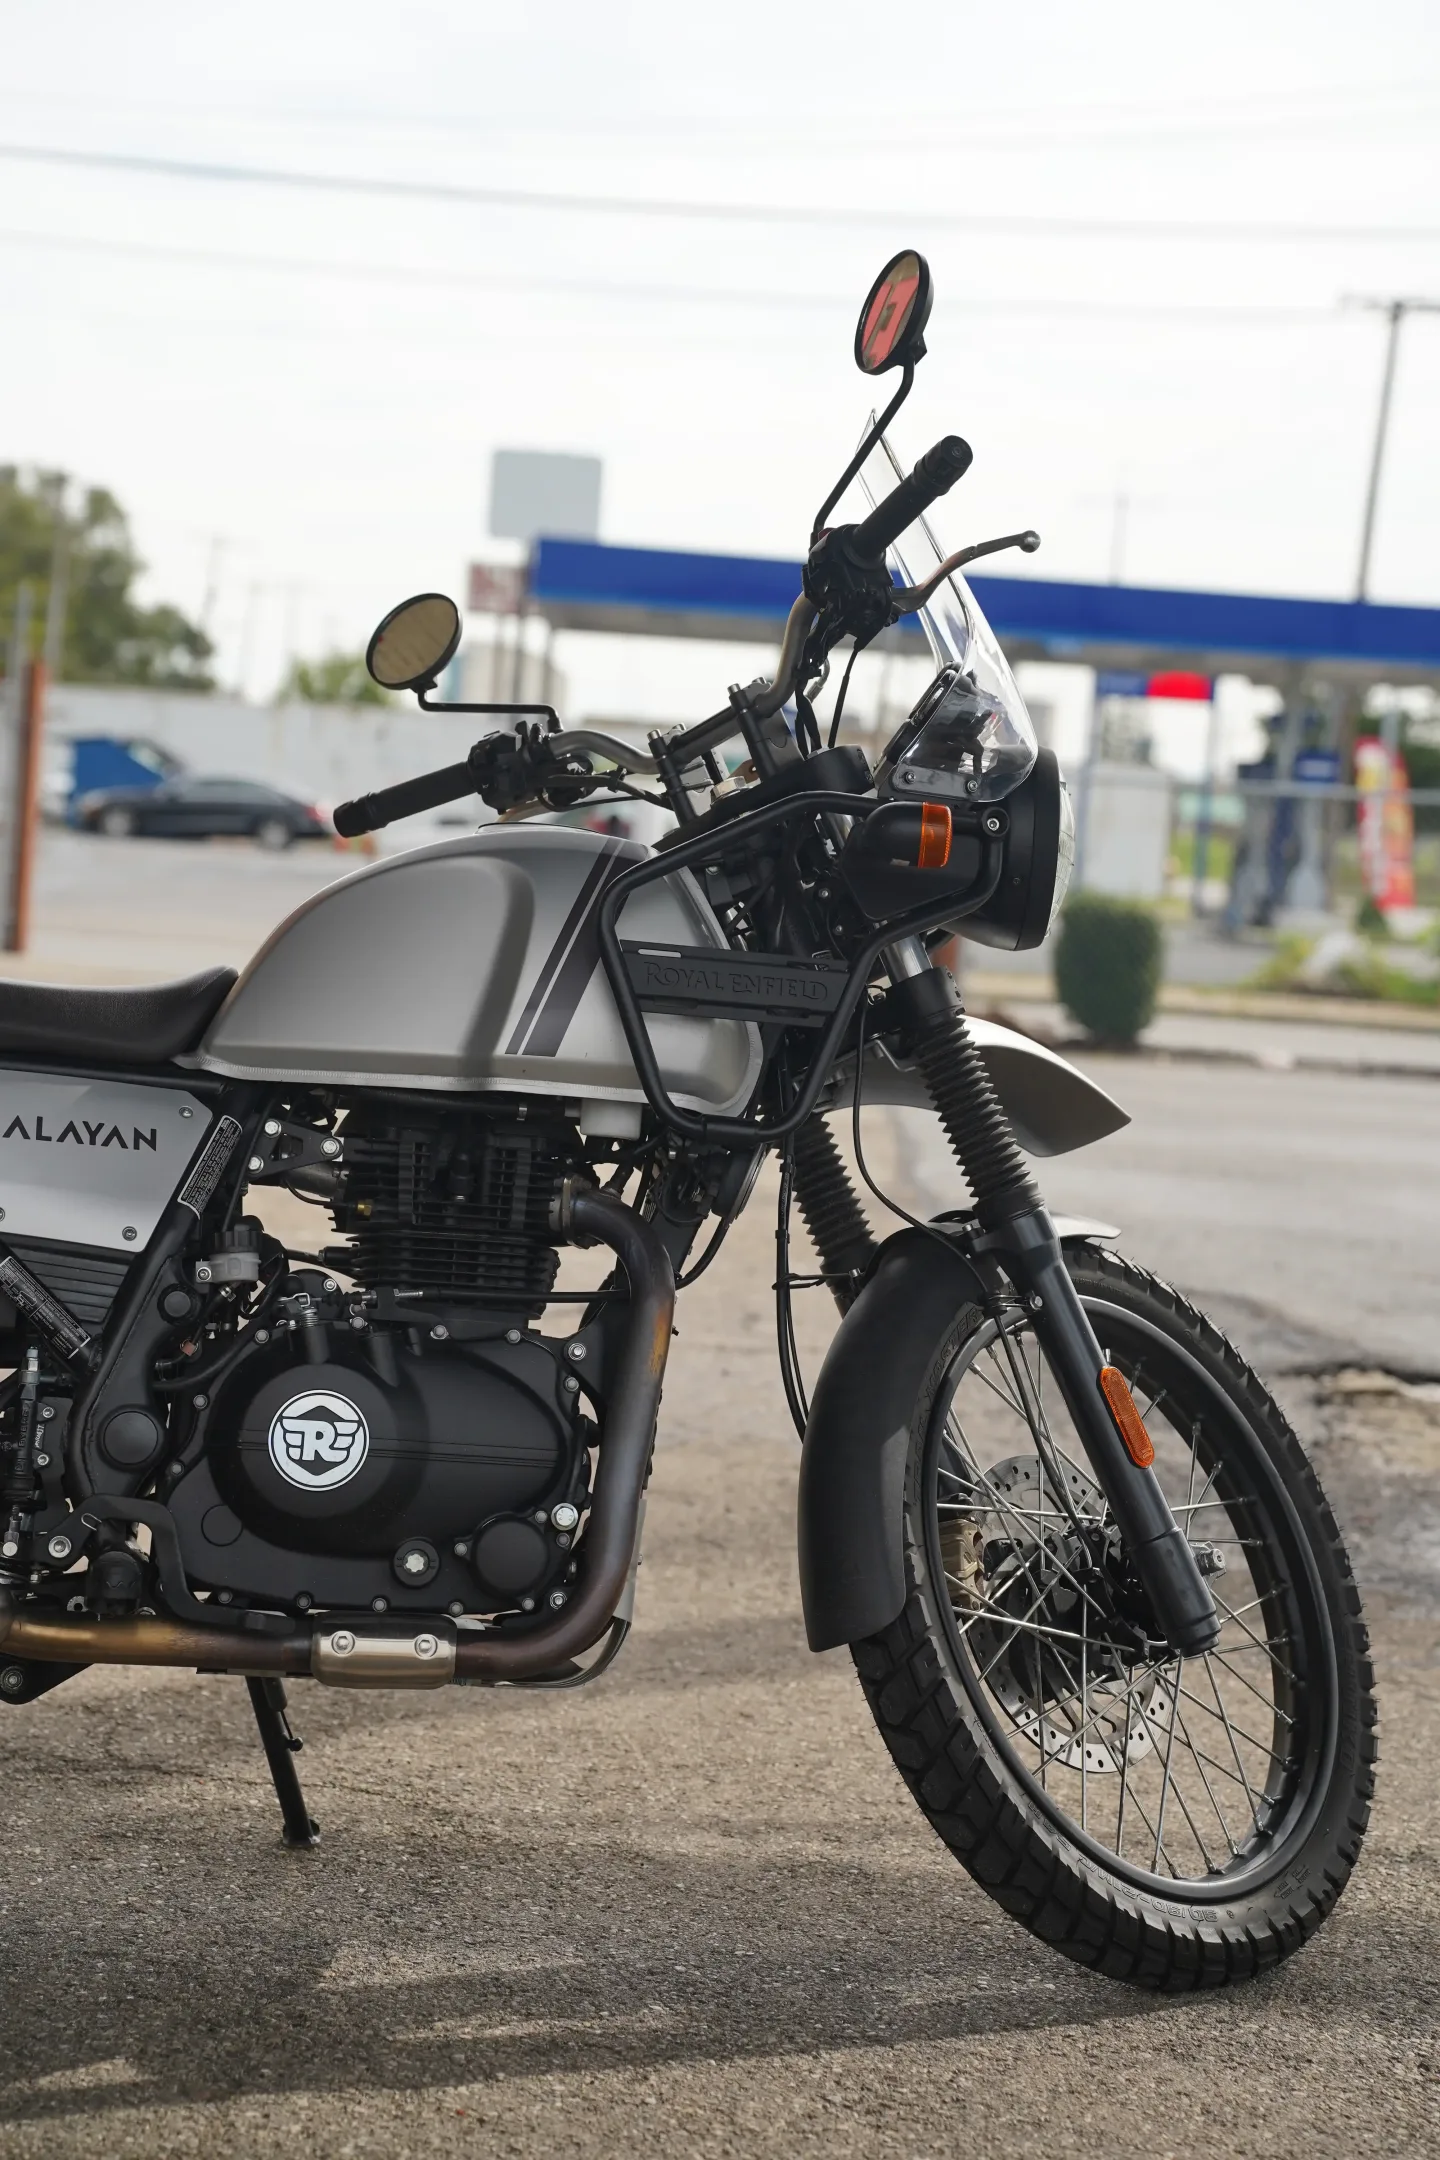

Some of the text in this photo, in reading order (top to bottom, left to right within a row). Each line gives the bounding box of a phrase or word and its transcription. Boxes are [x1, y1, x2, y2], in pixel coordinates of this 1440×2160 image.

[643, 961, 828, 1000] ROYAL ENFIELD
[2, 1114, 157, 1152] ALAYAN
